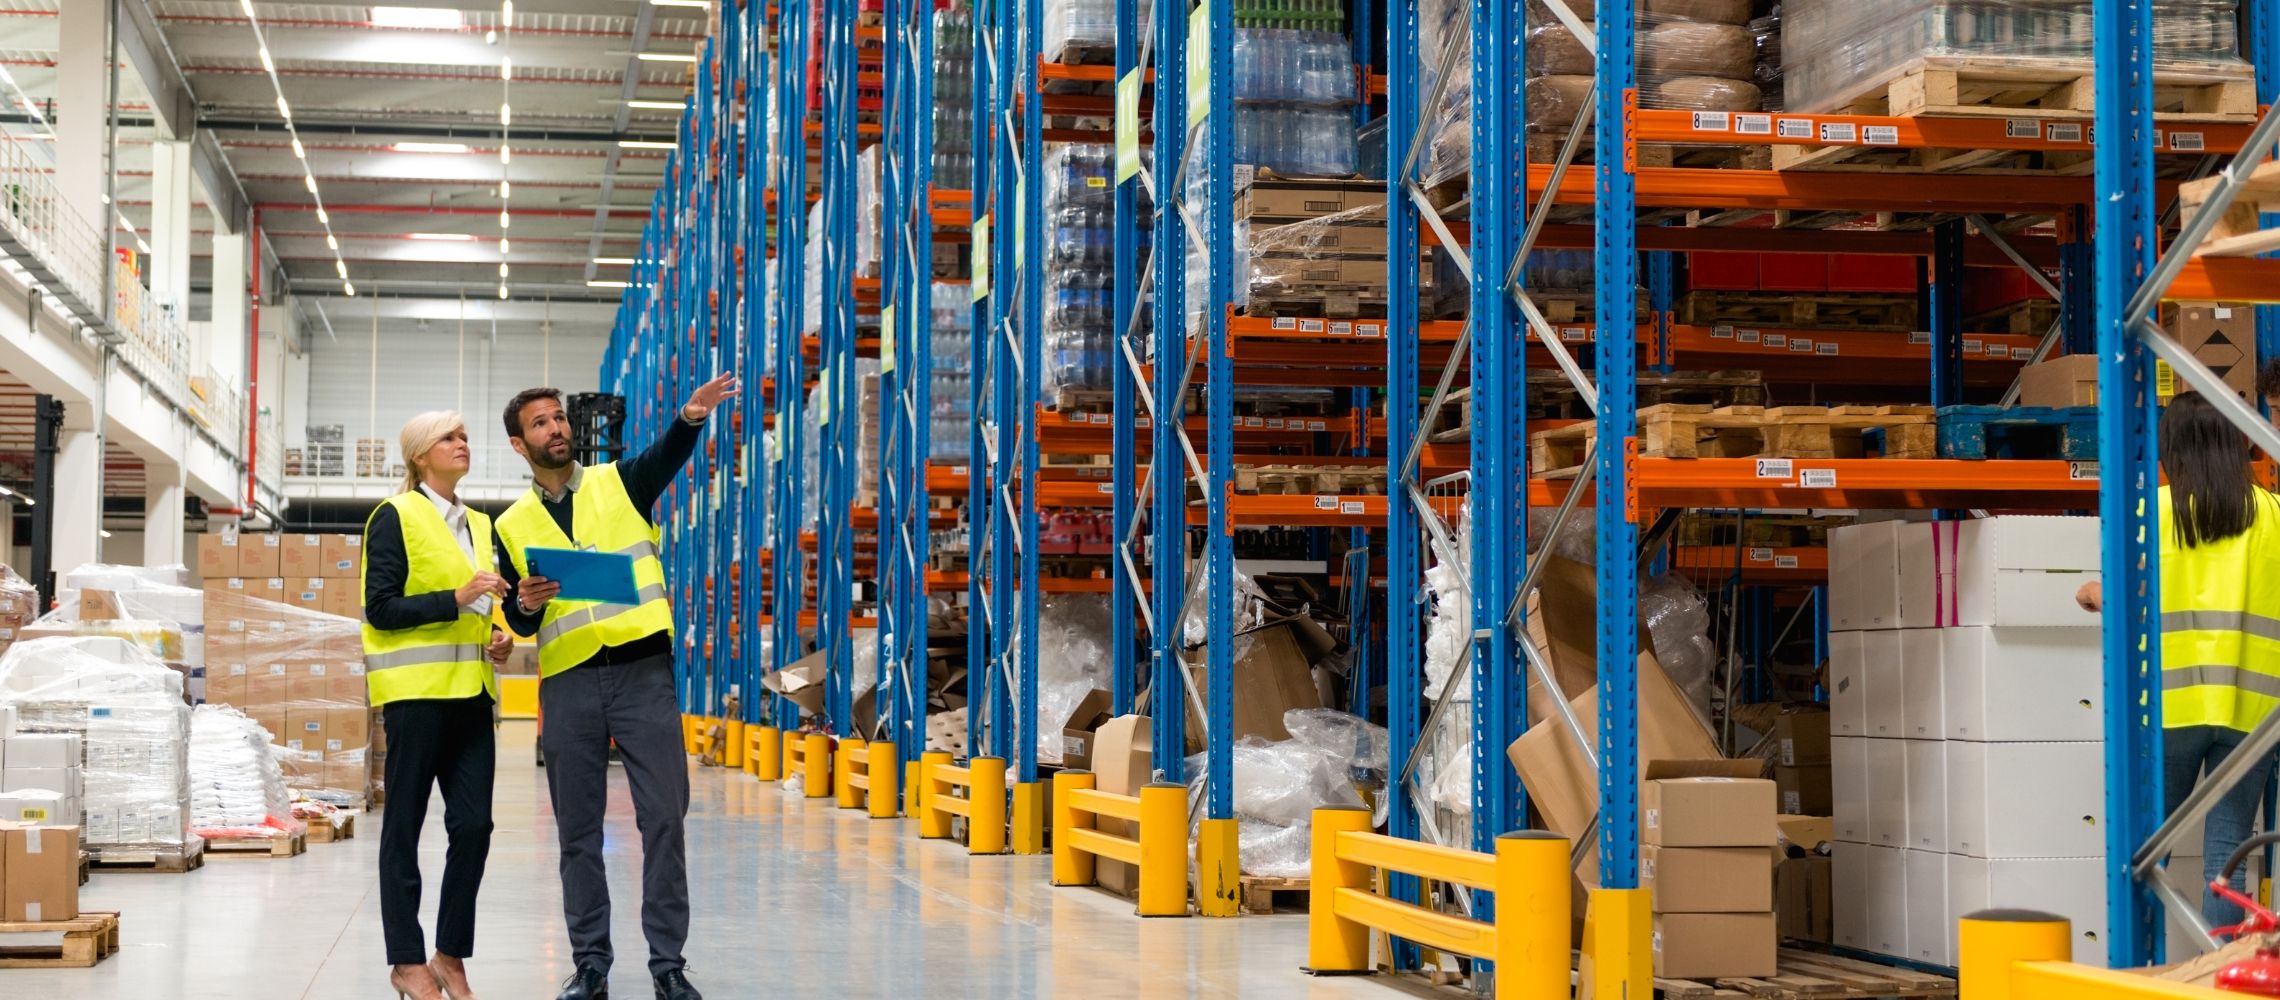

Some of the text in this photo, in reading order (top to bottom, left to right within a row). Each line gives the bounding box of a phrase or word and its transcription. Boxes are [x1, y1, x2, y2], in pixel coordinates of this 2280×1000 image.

[1192, 15, 1207, 77] 10
[1120, 84, 1132, 138] 11
[1694, 113, 1700, 128] 8
[1737, 116, 1743, 131] 7
[1779, 120, 1785, 135] 6
[1822, 125, 1828, 139] 5
[1864, 128, 1870, 142] 4
[2007, 121, 2013, 136] 8
[2048, 125, 2054, 140] 7
[2089, 128, 2095, 143] 6
[2171, 134, 2177, 148] 4
[1272, 318, 1277, 328] 8
[1300, 320, 1305, 330] 7
[1328, 323, 1333, 333] 6
[1357, 326, 1361, 335] 5
[1563, 329, 1568, 339] 5
[1738, 331, 1742, 340] 7
[1764, 335, 1768, 345] 6
[1790, 340, 1795, 350] 5
[1816, 344, 1821, 353] 4
[1758, 461, 1764, 476] 2
[2072, 463, 2078, 478] 2
[1802, 471, 1807, 486] 1
[1315, 497, 1320, 507] 2
[1342, 503, 1346, 512] 1
[1751, 549, 1755, 559] 2
